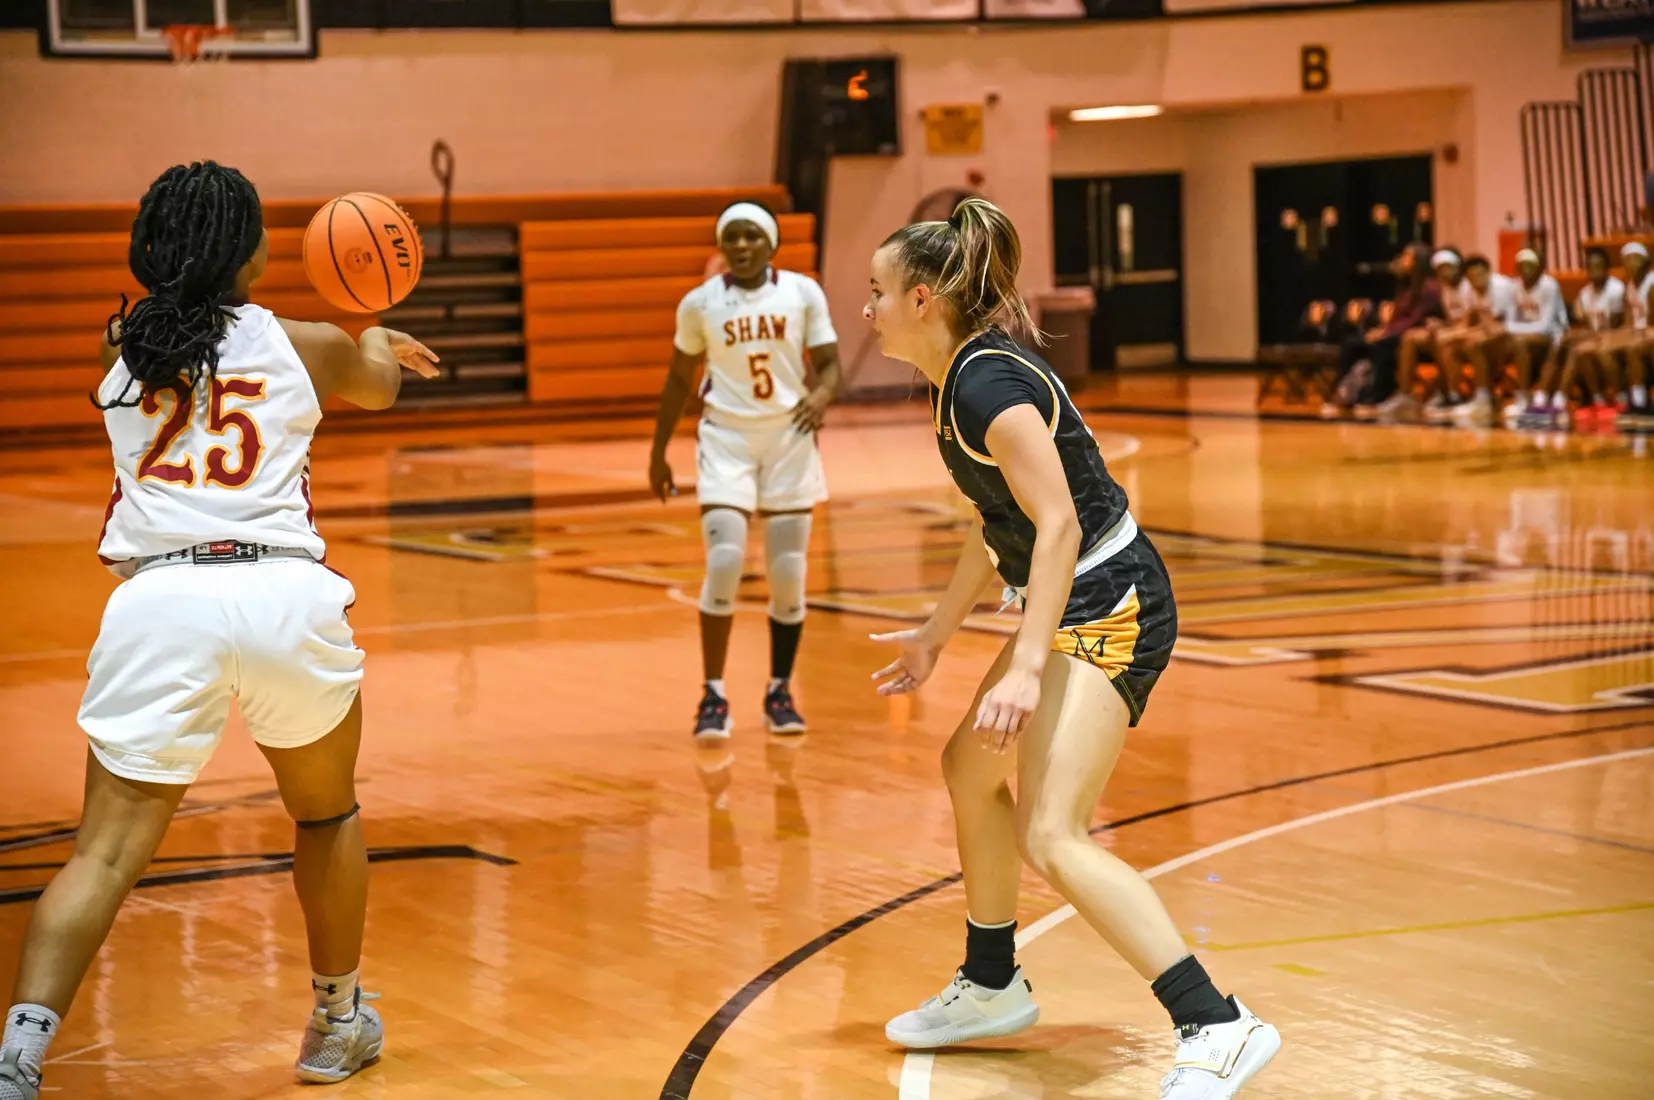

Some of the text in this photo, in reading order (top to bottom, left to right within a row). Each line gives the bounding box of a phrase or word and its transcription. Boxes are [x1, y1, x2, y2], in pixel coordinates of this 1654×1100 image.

[1301, 45, 1330, 92] B
[723, 314, 787, 347] SHAW
[748, 352, 774, 400] 5
[137, 374, 267, 490] 25
